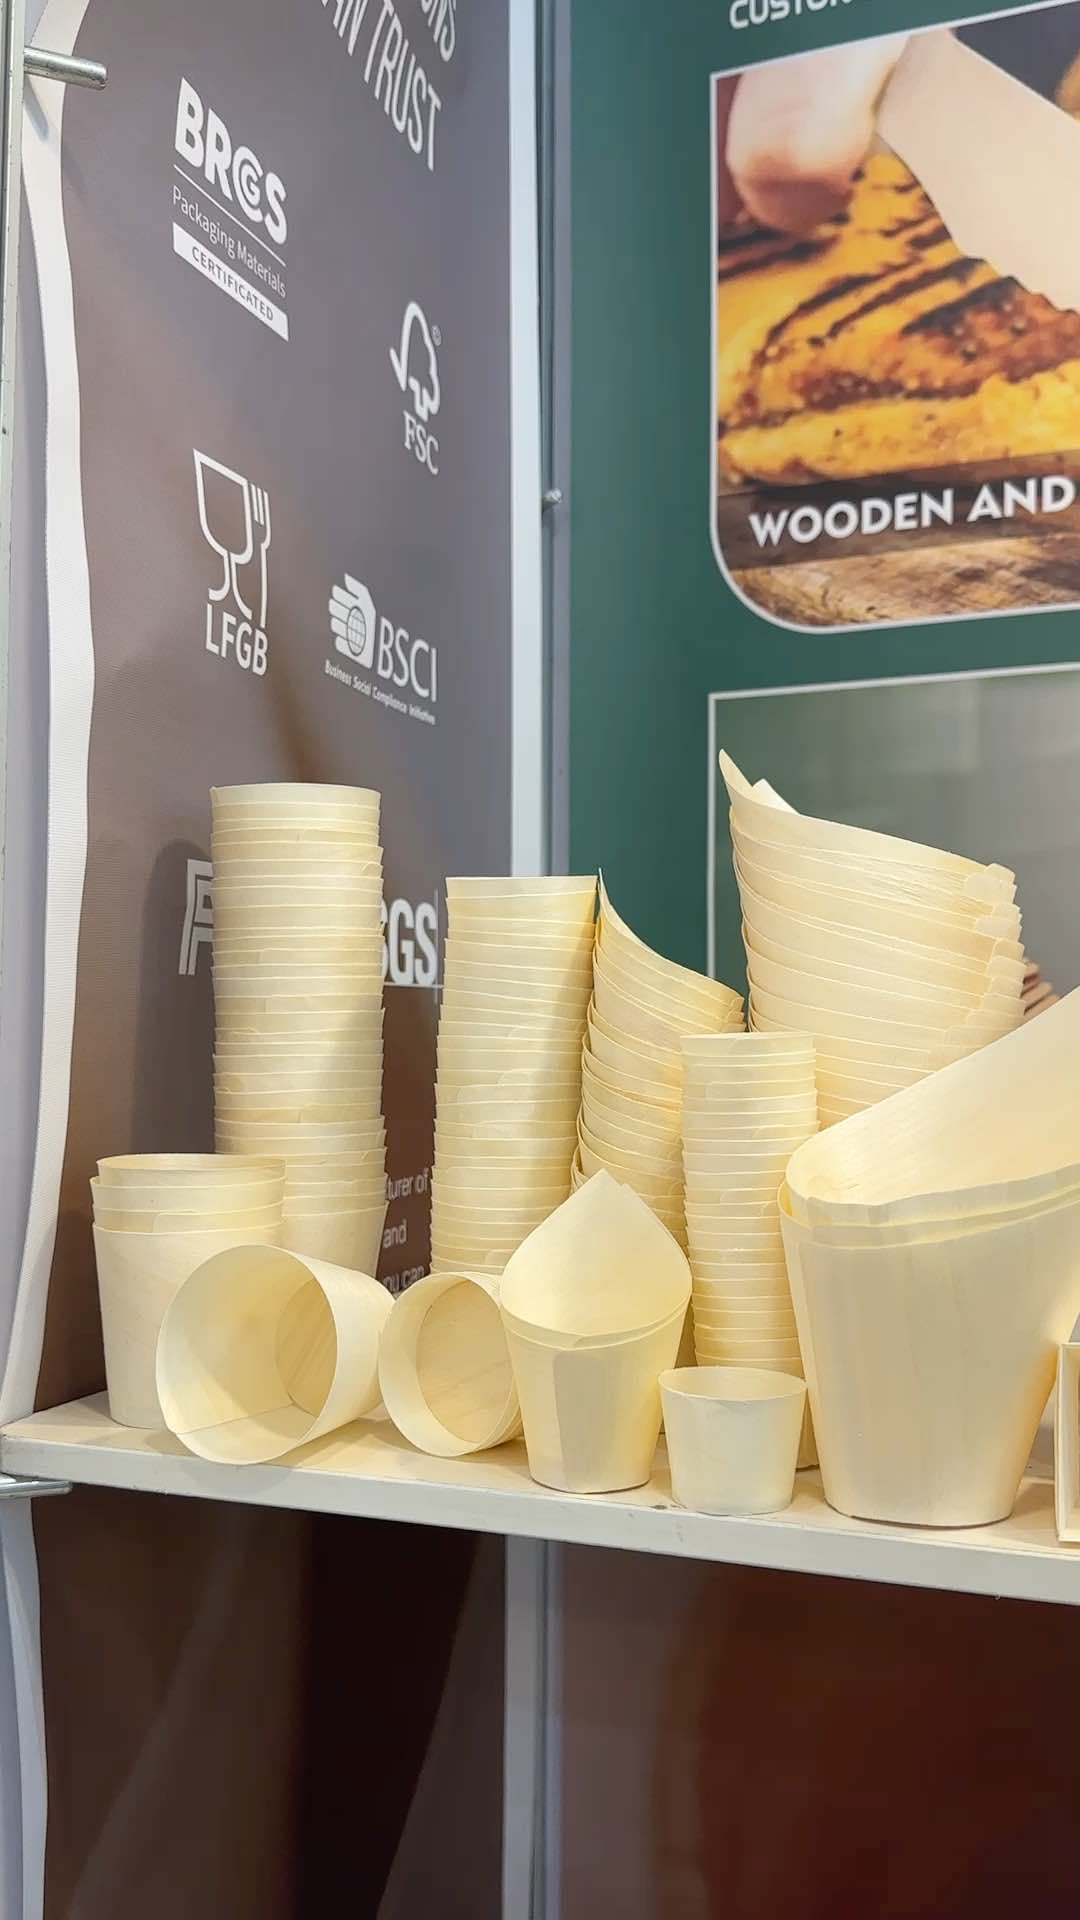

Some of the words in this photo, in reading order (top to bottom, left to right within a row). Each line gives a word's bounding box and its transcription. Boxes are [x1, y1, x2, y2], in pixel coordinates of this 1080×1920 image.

[364, 0, 442, 171] TRUST
[173, 185, 236, 260] Packaging
[237, 241, 286, 298] Materials
[192, 246, 274, 321] CERTIFICATED
[403, 410, 439, 475] FSC
[749, 488, 954, 548] WOODEN
[966, 475, 1076, 523] AND
[206, 603, 268, 676] LFGB
[377, 616, 437, 703] BSCI
[383, 1219, 407, 1249] and
